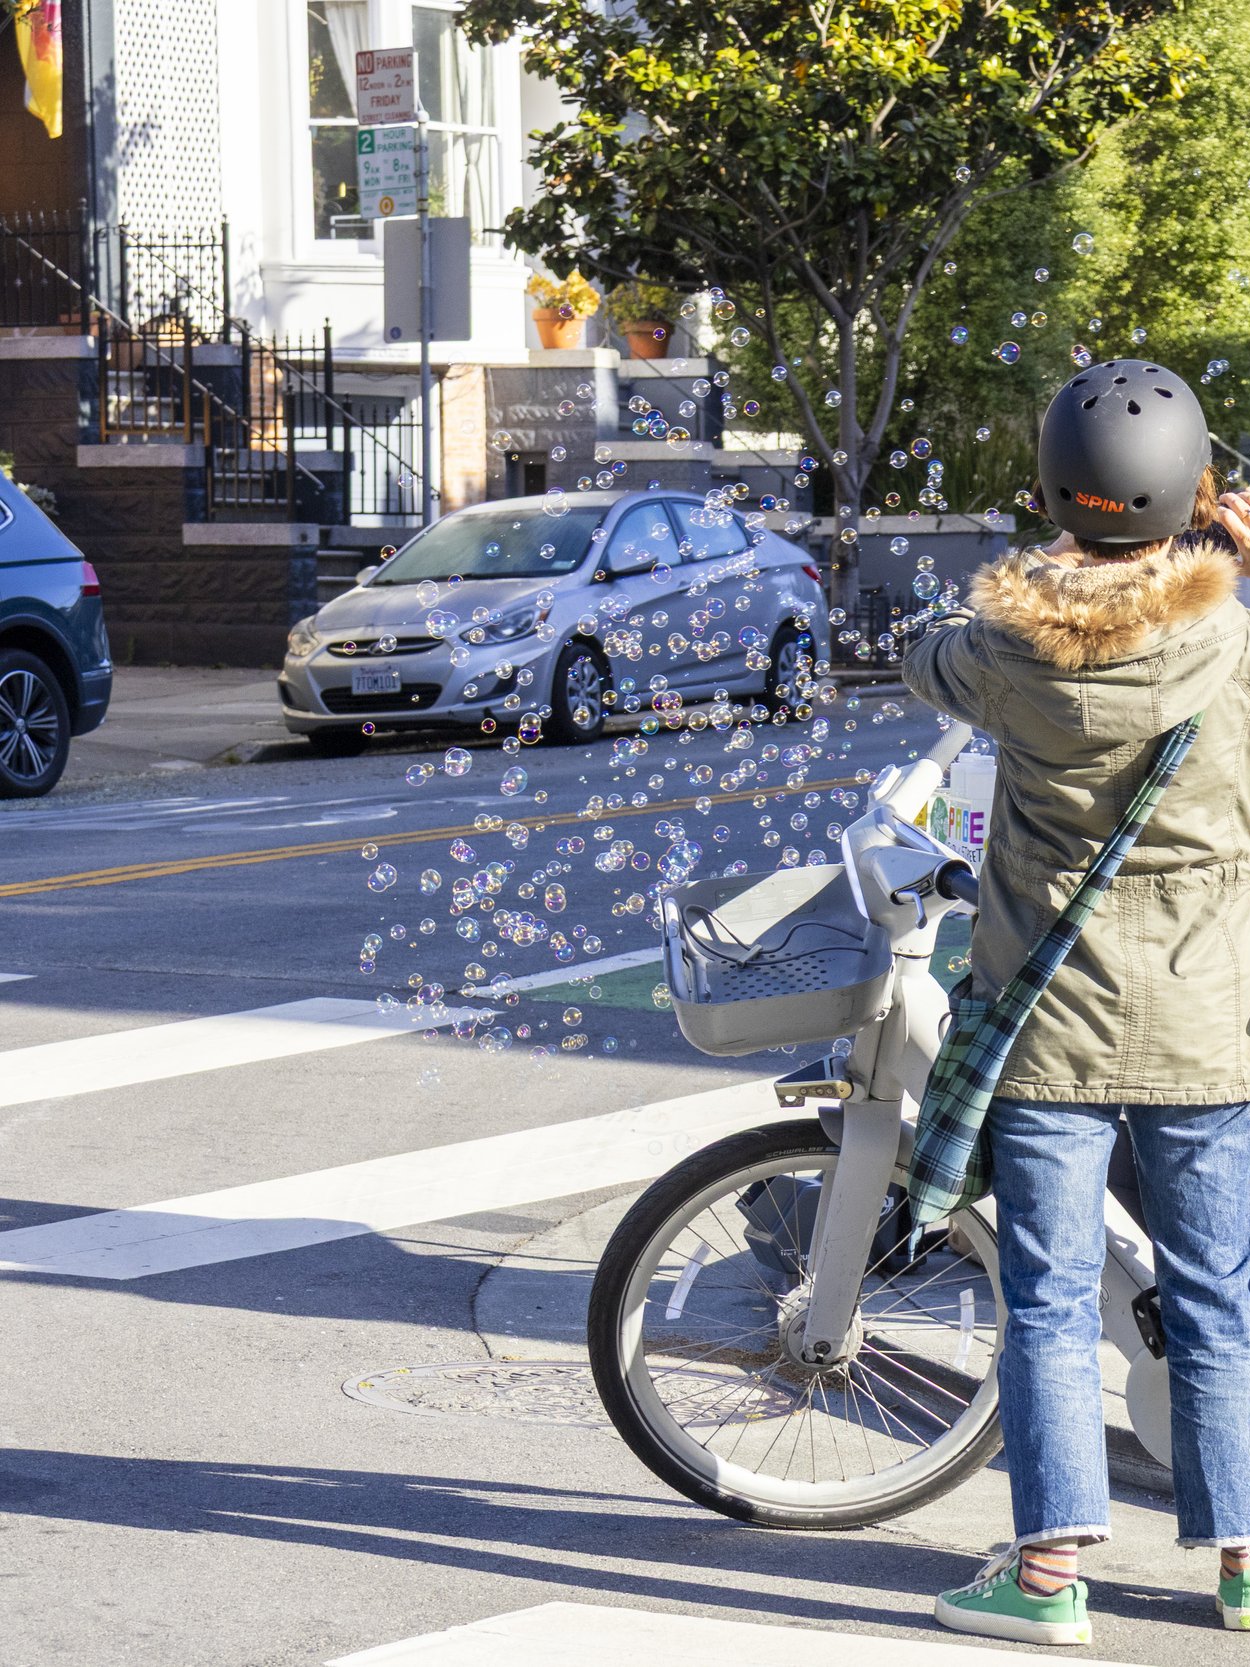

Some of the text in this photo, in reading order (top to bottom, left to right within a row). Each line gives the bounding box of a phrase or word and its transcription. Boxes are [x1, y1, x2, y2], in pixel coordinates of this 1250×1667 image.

[357, 53, 412, 72] NO PARKING
[370, 94, 401, 108] FRIDAY
[362, 111, 411, 122] STREET CLEANING
[383, 129, 406, 139] HOUR
[361, 133, 372, 153] 2
[377, 141, 412, 152] PARKING
[365, 177, 379, 186] MON
[398, 174, 410, 183] FRI
[1076, 491, 1125, 513] SPIN
[948, 806, 984, 844] PAGE
